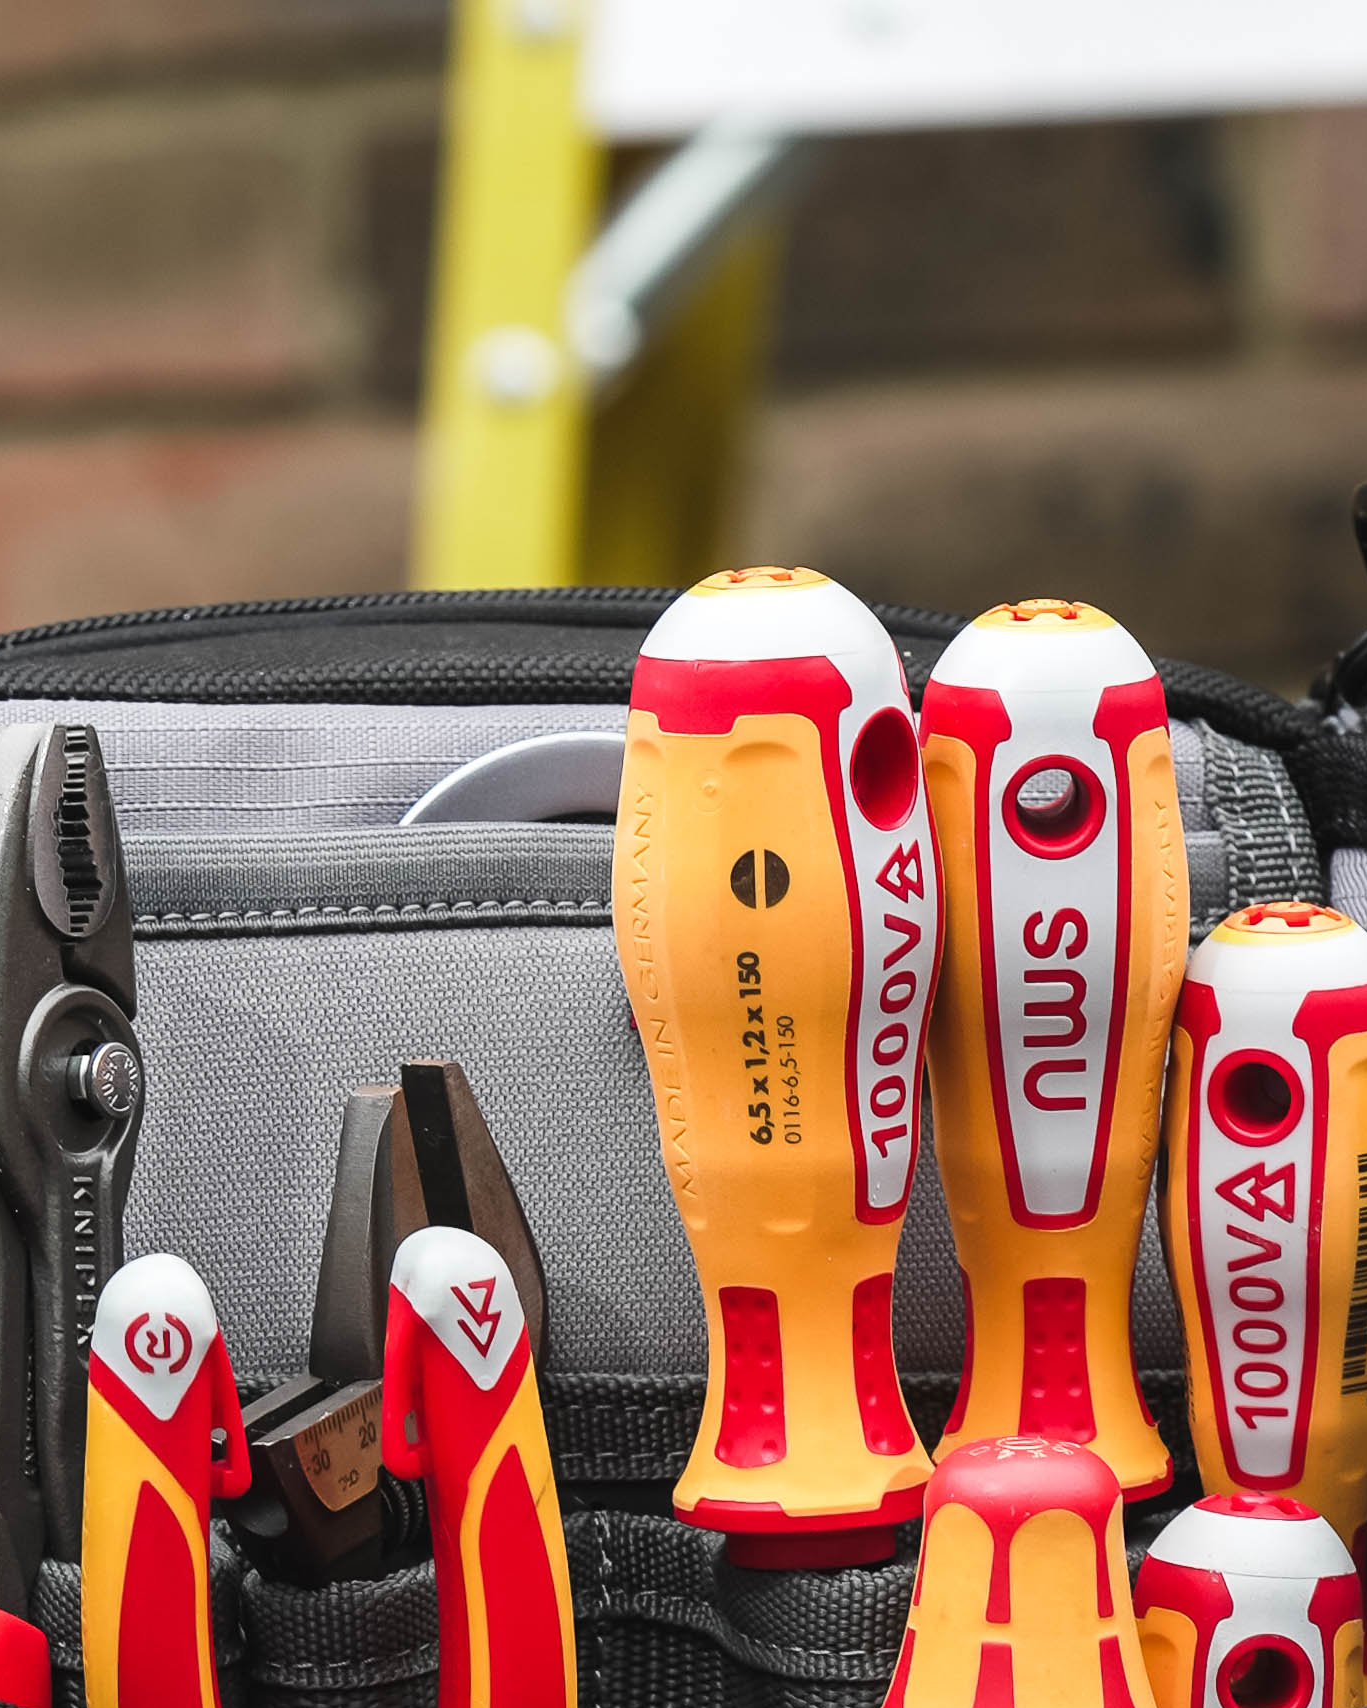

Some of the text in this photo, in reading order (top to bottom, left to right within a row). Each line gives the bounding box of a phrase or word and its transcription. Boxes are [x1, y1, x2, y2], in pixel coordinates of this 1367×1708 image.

[630, 783, 697, 1199] MADE IN GERMANY
[738, 951, 772, 1145] 6,5 x 1,2 x 150
[777, 1015, 801, 1145] 0116-6,5-150
[870, 913, 921, 1158] 1000V
[73, 1176, 97, 1345] KNIPEX
[1226, 1224, 1289, 1429] 1000V
[358, 1421, 376, 1449] 20
